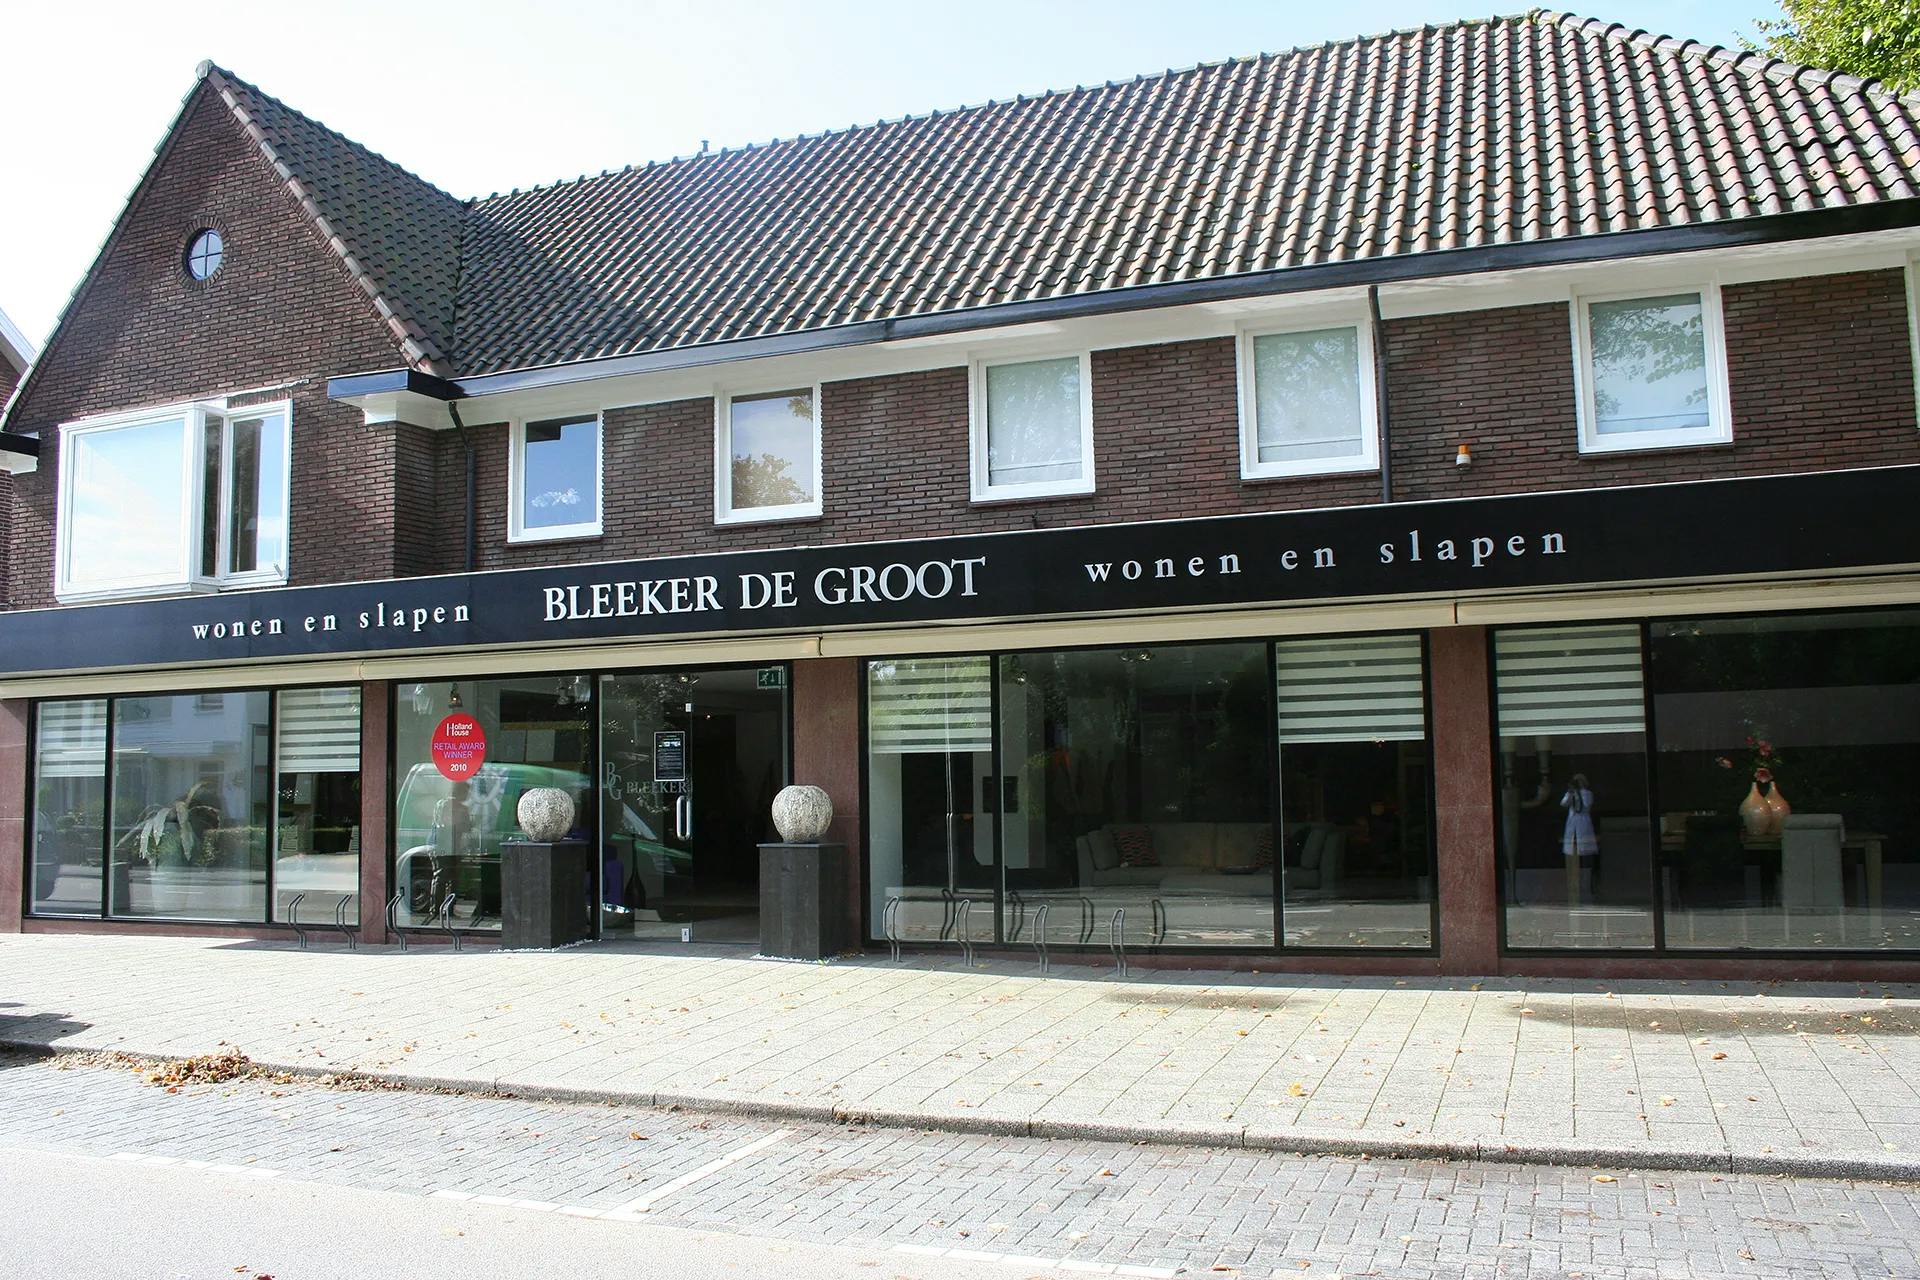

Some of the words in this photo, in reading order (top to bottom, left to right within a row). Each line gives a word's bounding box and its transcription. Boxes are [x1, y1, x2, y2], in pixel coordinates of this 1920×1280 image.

[1085, 553, 1241, 582] wonen
[1281, 547, 1336, 570] en
[1380, 529, 1566, 567] slapen
[543, 575, 724, 622] BLEEKER
[739, 571, 798, 610] DE
[814, 556, 986, 605] GROOT
[192, 618, 282, 640] wonen
[304, 614, 337, 632] en
[359, 602, 470, 632] slapen
[433, 742, 458, 751] RETAIL
[458, 742, 486, 751] AWARD
[443, 750, 473, 759] WINNER
[450, 763, 468, 772] 2010
